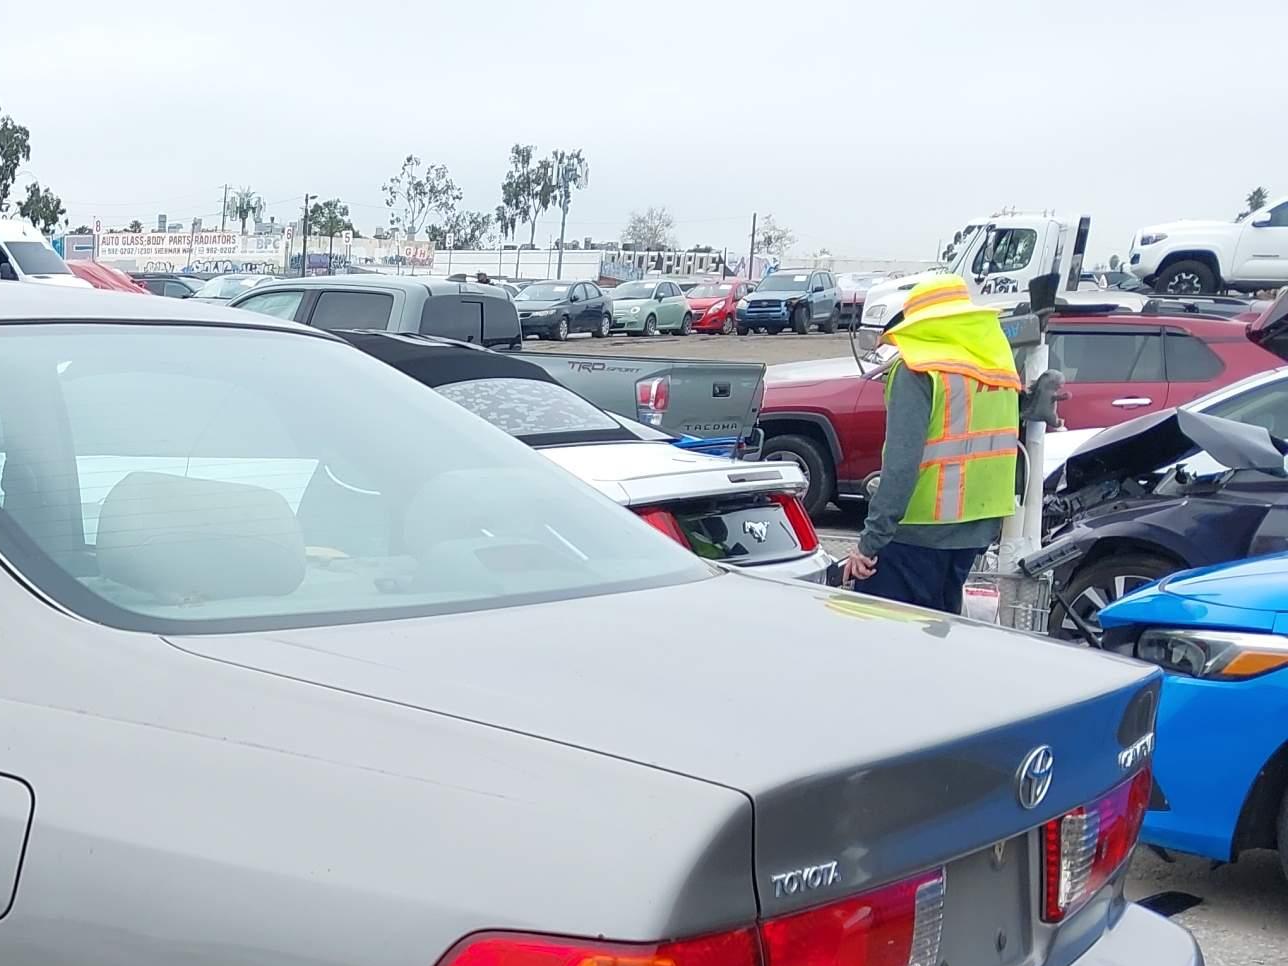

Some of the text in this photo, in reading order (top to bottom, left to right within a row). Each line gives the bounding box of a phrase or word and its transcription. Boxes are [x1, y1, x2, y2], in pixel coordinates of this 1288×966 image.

[95, 220, 101, 233] 8
[101, 236, 120, 246] AUTO
[168, 234, 192, 246] PARTS
[194, 233, 237, 245] RADIATORS
[286, 228, 292, 240] 6
[344, 231, 351, 244] 5
[446, 234, 453, 246] 3
[255, 238, 281, 250] BPC
[567, 360, 606, 374] TRD
[683, 422, 738, 431] TACOMA
[770, 860, 842, 898] TOYOTA
